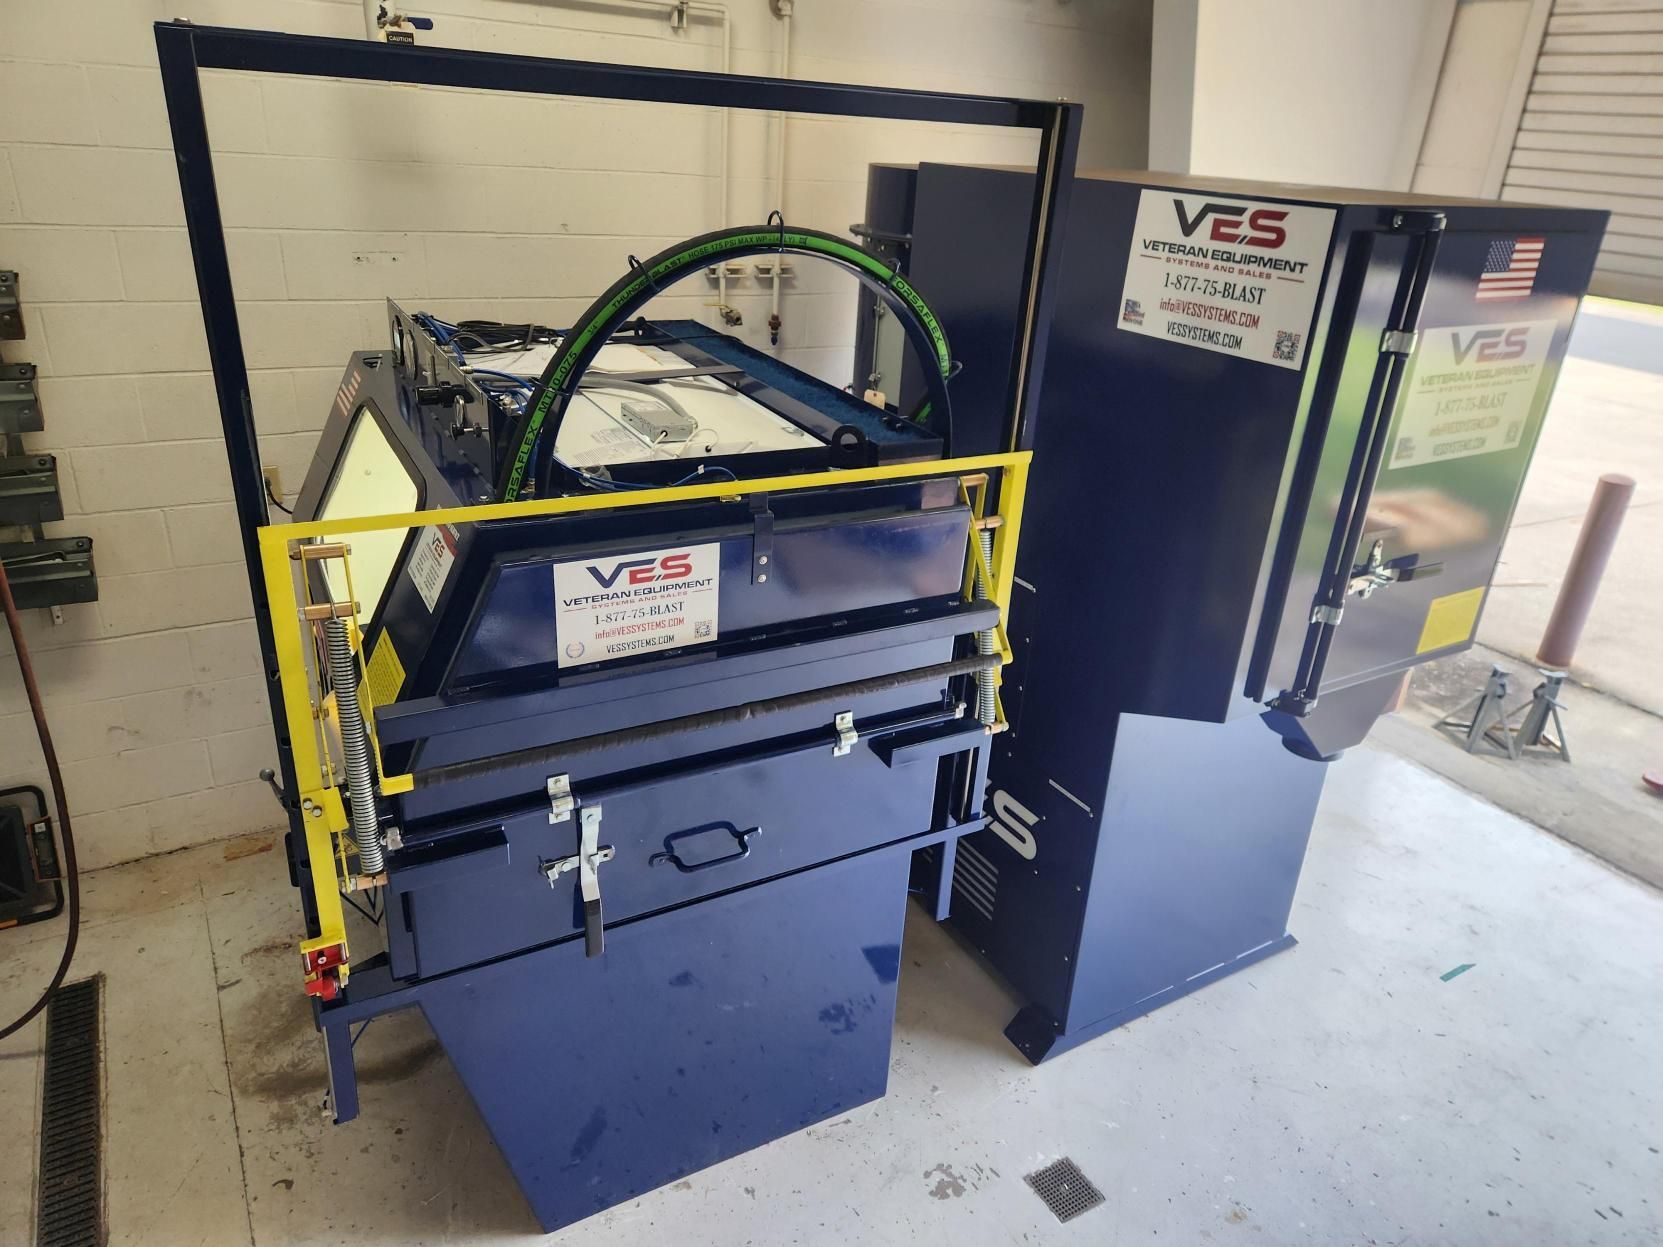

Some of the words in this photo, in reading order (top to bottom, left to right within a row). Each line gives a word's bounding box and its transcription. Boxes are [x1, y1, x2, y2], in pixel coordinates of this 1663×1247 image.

[388, 35, 413, 43] CAUTION
[1173, 198, 1289, 249] VES
[688, 247, 711, 260] HOSE
[711, 241, 723, 252] 175
[724, 239, 737, 249] PSI
[737, 237, 754, 245] MAX
[1142, 238, 1212, 260] VETERAN
[1211, 249, 1308, 275] EQUIPMENT
[1165, 256, 1210, 270] SYSTEMS
[1213, 263, 1234, 274] AND
[1238, 266, 1272, 280] SALES
[1163, 272, 1266, 305] 1-877-75-BLAST
[1159, 298, 1260, 330] info@VESSYSTEMS.COM
[1167, 321, 1243, 351] VESSYSTEMS.COM
[1450, 326, 1531, 366] VES
[432, 532, 446, 559] VES
[585, 553, 692, 589] VES
[563, 590, 631, 607] VETERAN
[633, 578, 713, 597] EQUIPMENT
[591, 597, 636, 610] SYSTEMS
[638, 594, 658, 603] AND
[659, 590, 688, 600] SALES
[594, 601, 685, 625] 1-877-75-BLAST
[595, 616, 685, 640] info@VESSYSTEMS.COM
[606, 634, 675, 654] VESSYSTEMS.COM
